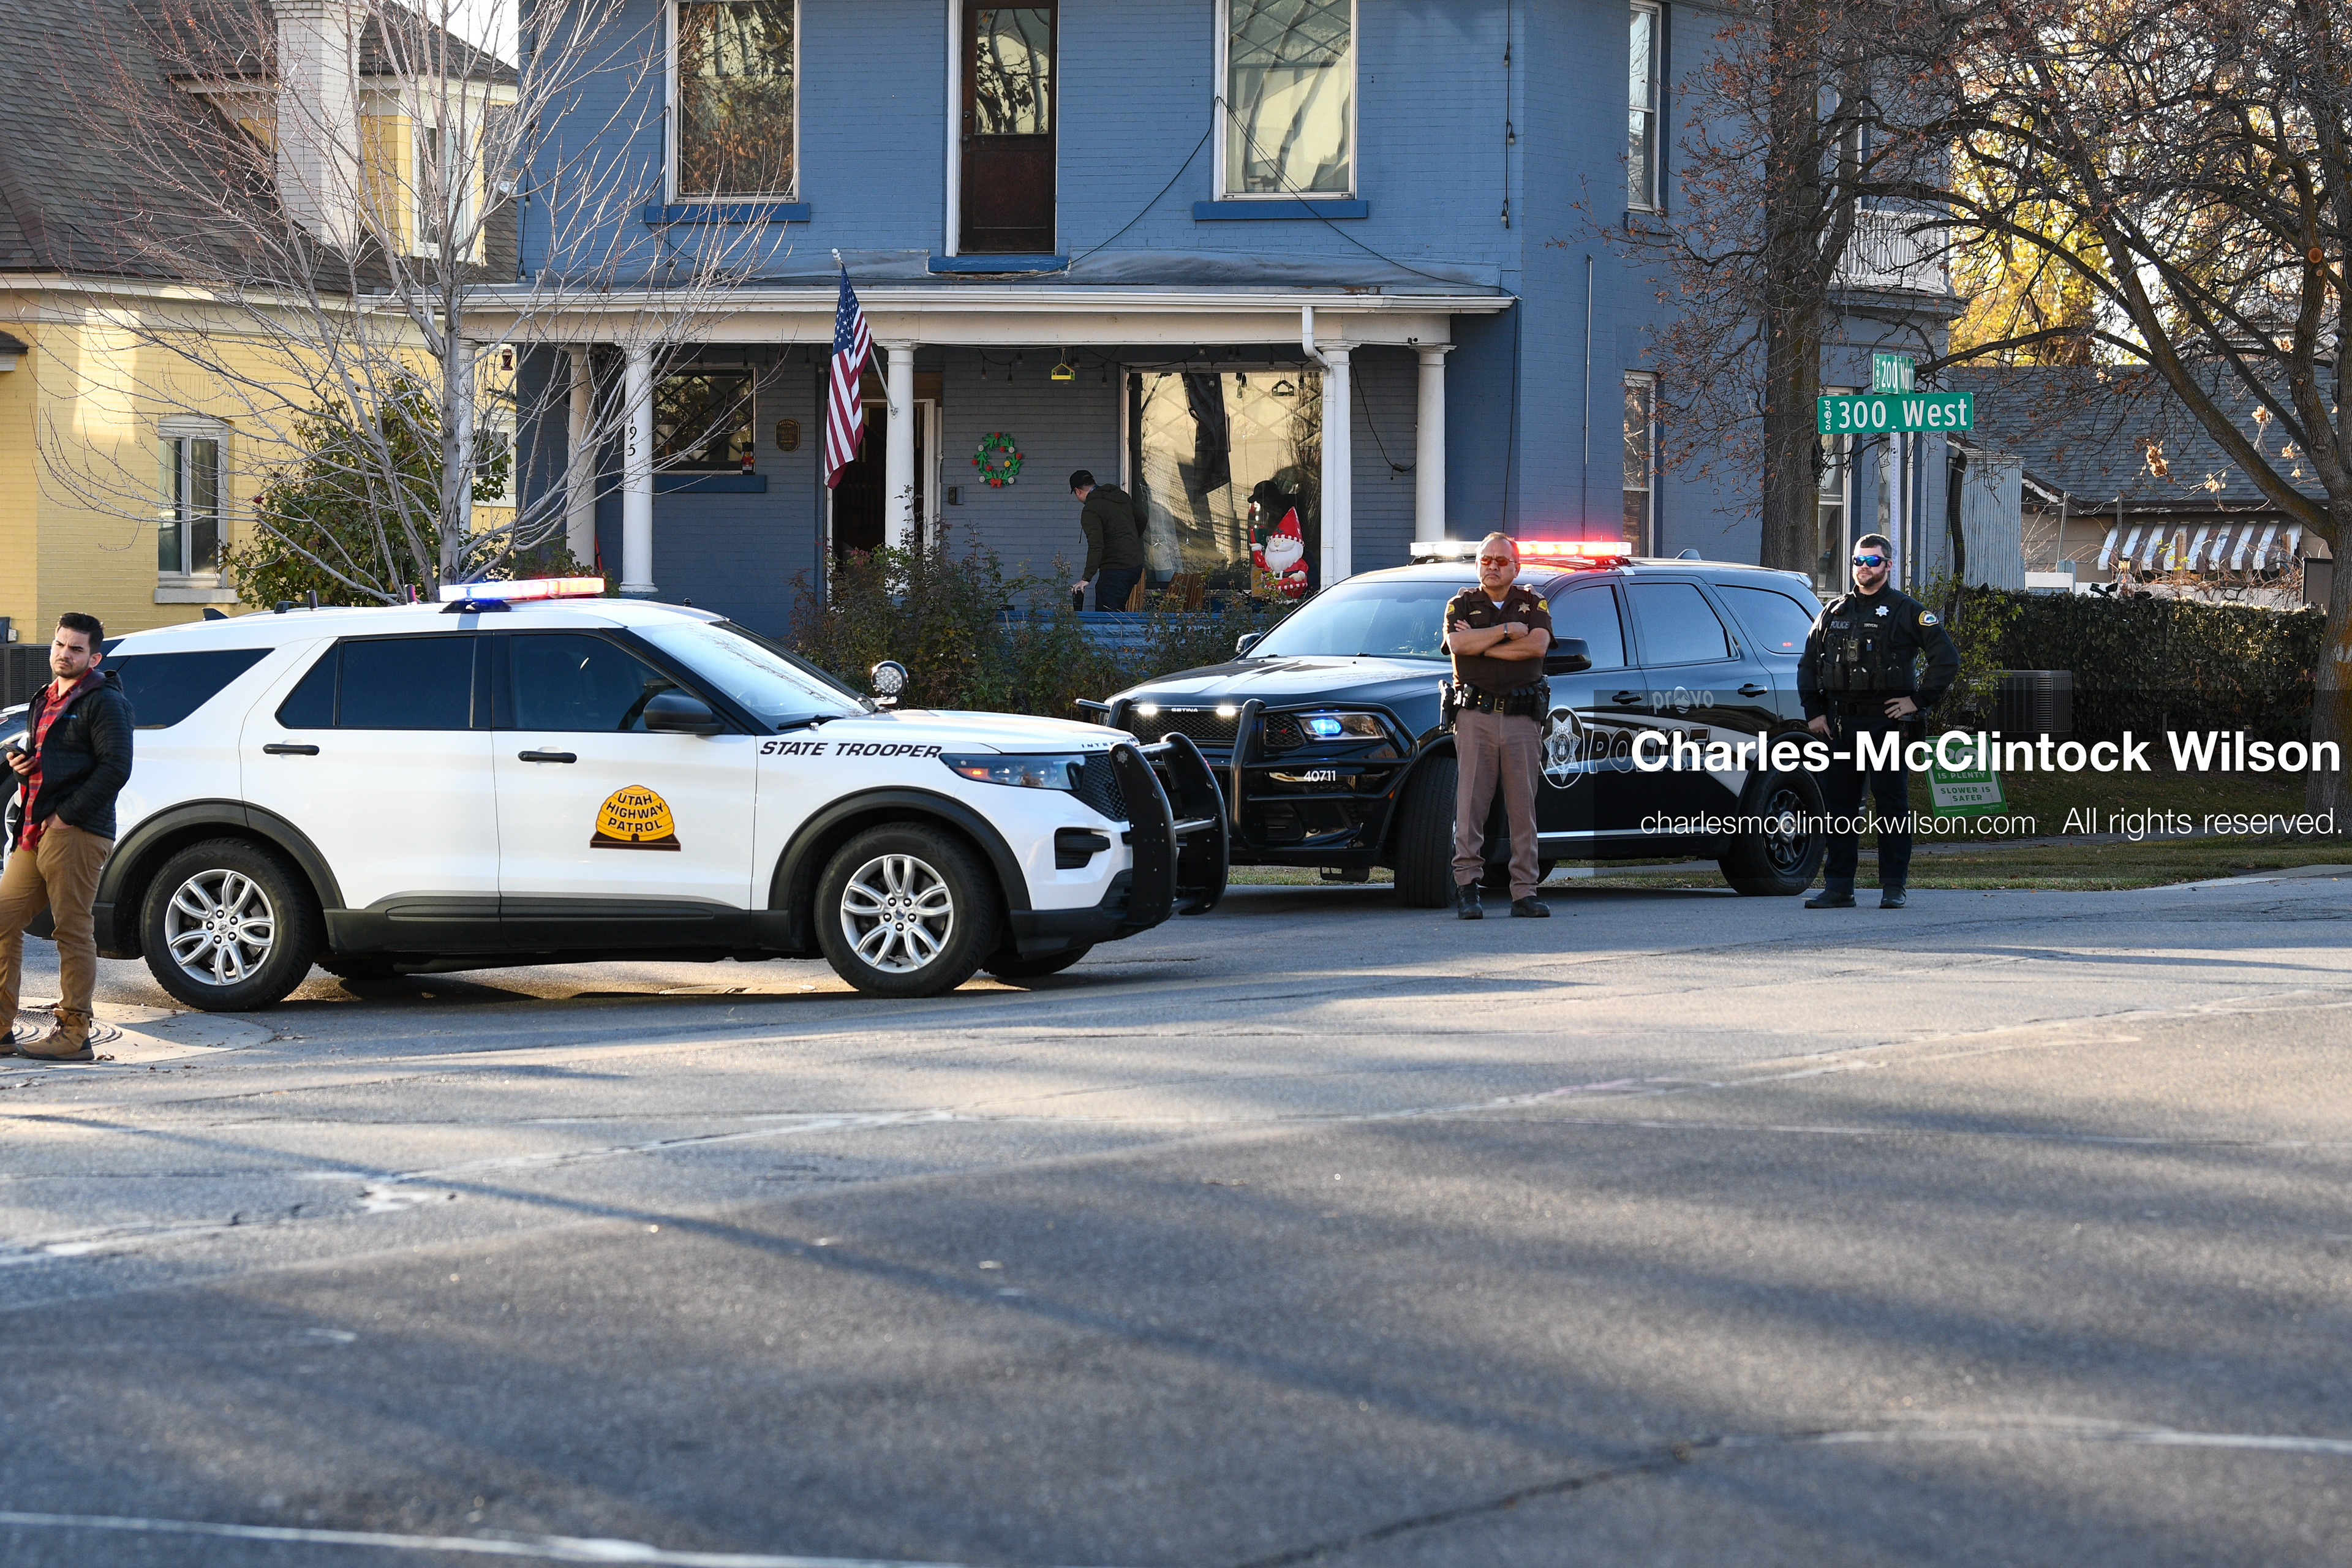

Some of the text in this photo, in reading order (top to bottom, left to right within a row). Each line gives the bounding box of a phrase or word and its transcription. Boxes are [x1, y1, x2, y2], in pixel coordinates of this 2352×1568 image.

[1881, 361, 1914, 390] 200 North
[1823, 400, 1832, 431] provo
[1839, 398, 1967, 428] 300 West
[1831, 620, 1850, 629] POLICE
[1652, 686, 1714, 714] provo
[760, 741, 941, 758] STATE TROOPER
[1588, 726, 1710, 774] POLICE
[1303, 770, 1336, 782] 40711
[617, 793, 652, 806] UTAH
[606, 801, 663, 819] HIGHWAY
[608, 817, 663, 832] PATROL
